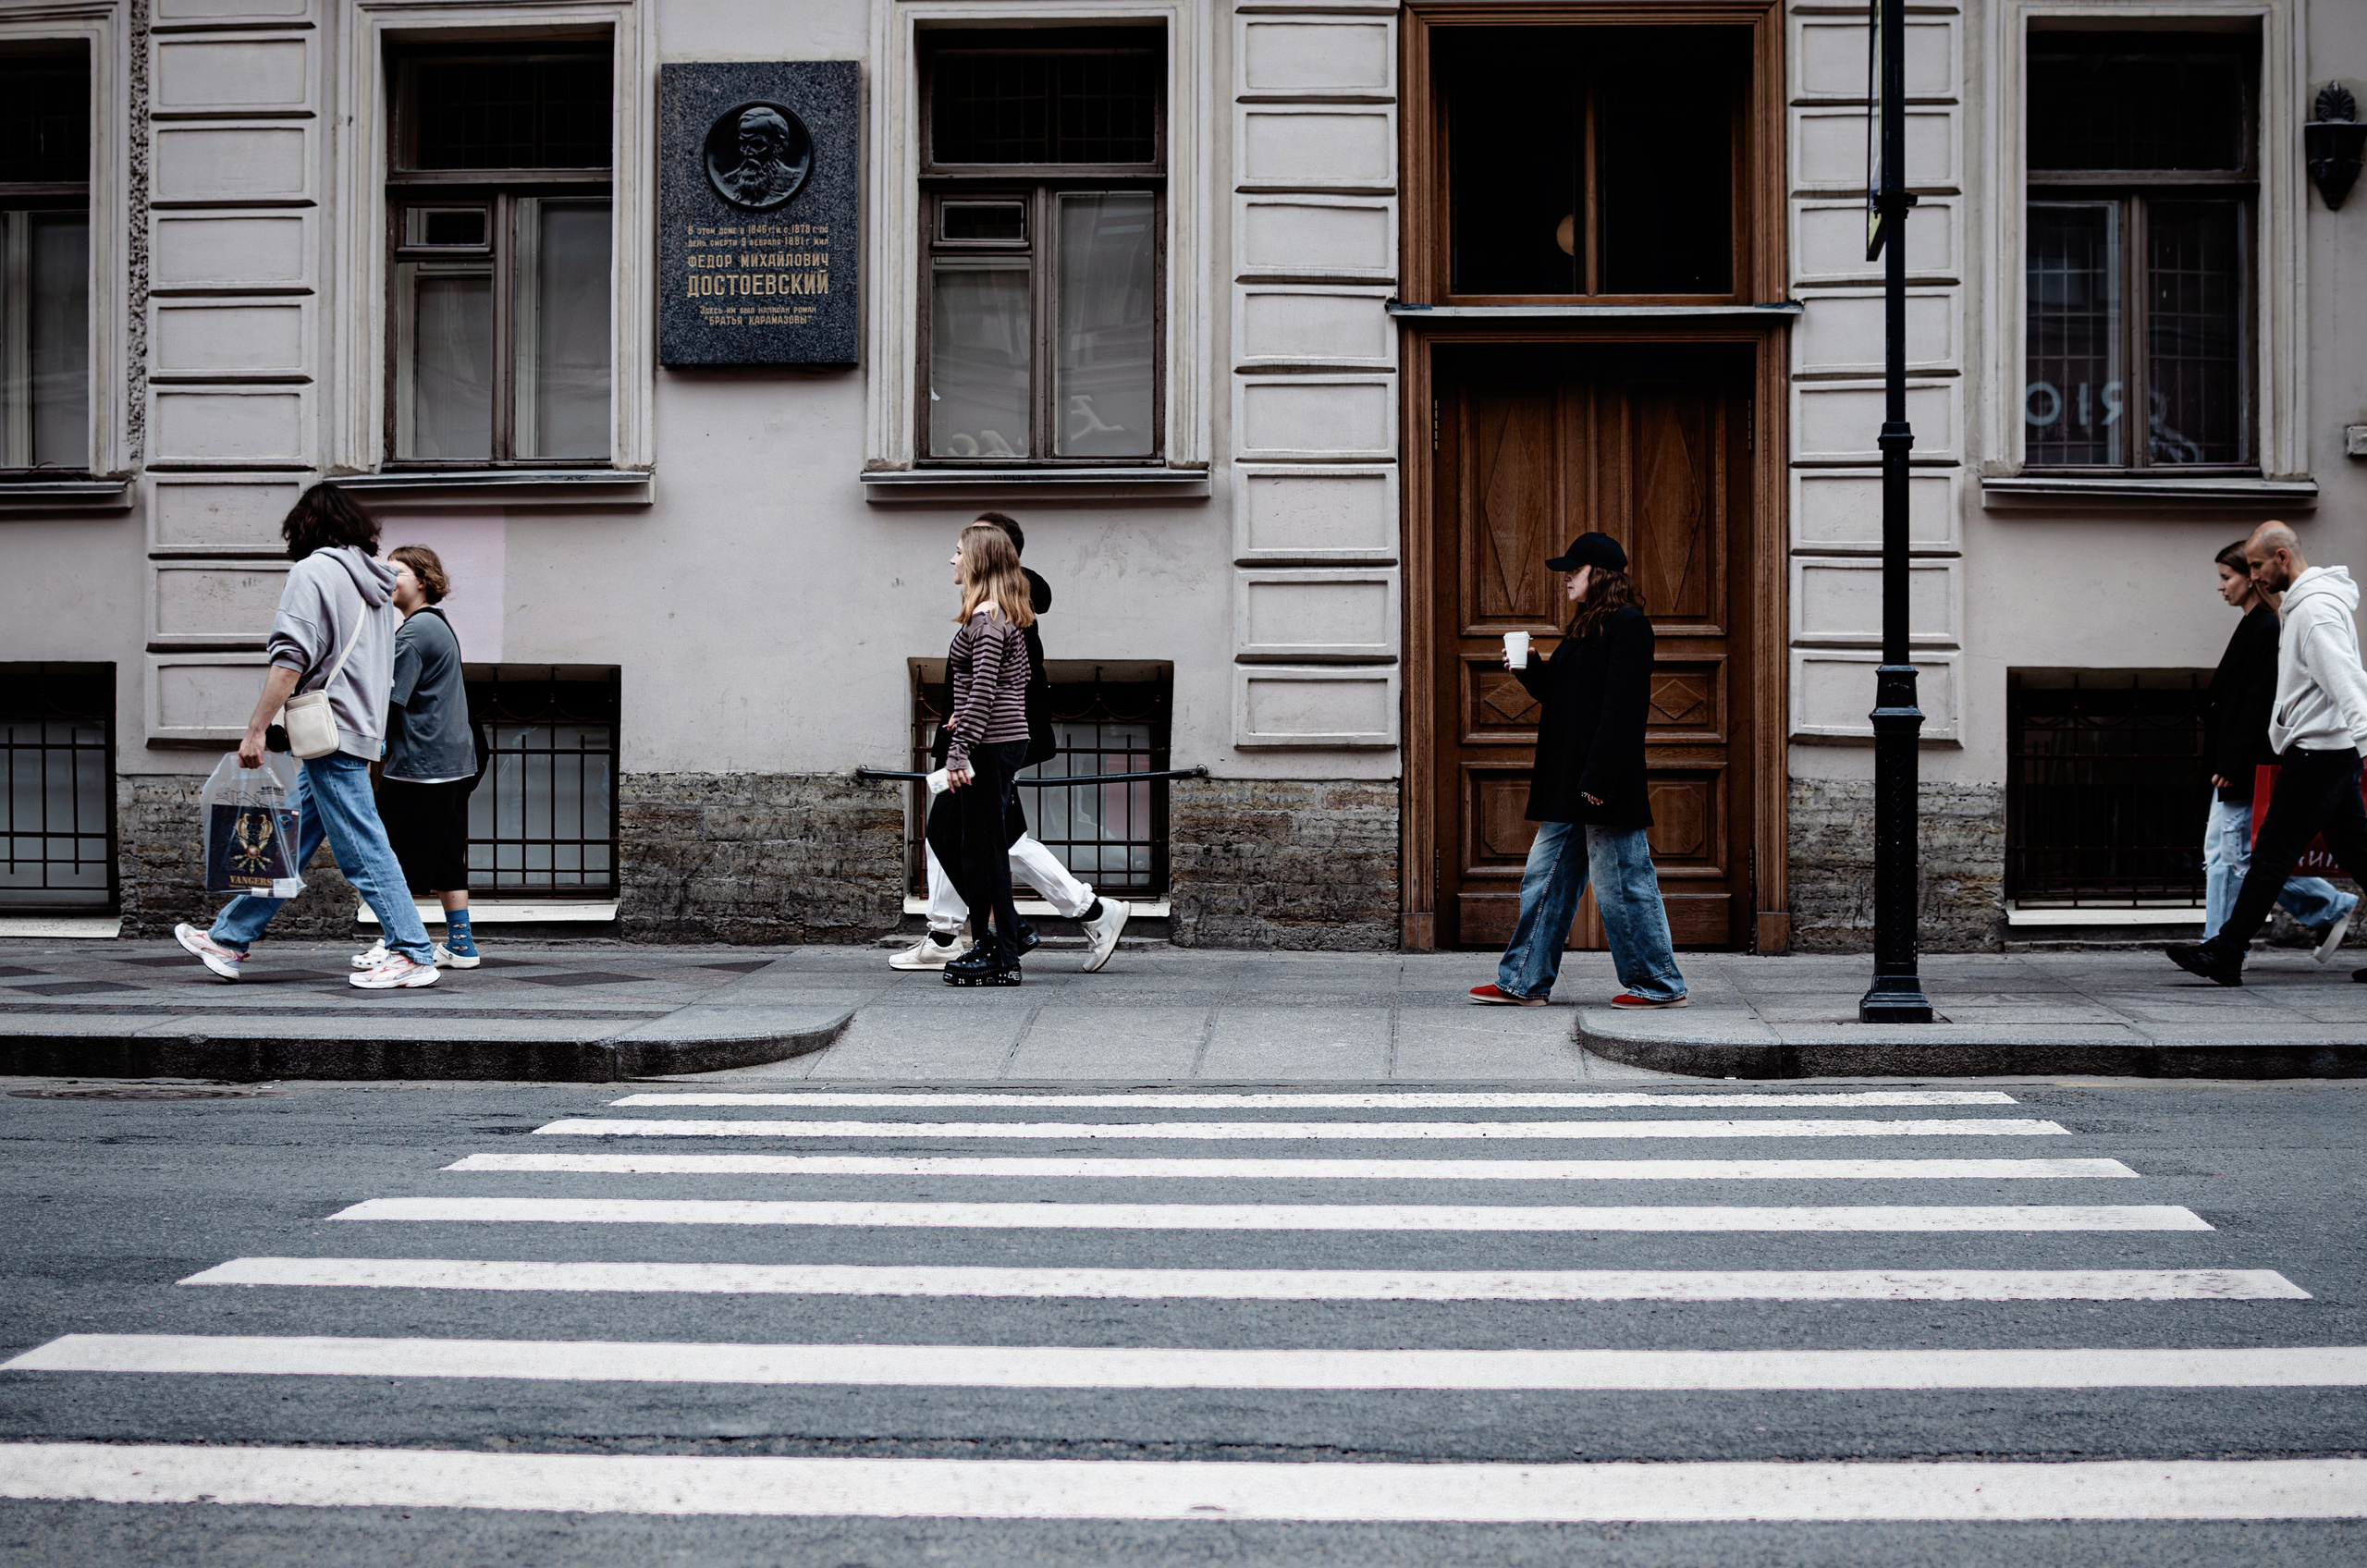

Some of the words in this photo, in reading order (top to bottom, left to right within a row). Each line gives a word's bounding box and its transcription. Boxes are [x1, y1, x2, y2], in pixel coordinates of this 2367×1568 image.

[688, 227, 693, 235] В
[748, 225, 767, 234] 1846
[741, 237, 746, 246] 9
[785, 237, 804, 245] 1881
[688, 254, 732, 267] ФЕДОР
[741, 251, 829, 267] МИХАЙЛОВИЧ
[687, 269, 828, 297] ДОСТОЕВСКИЙ
[230, 876, 273, 886] VANGERS
